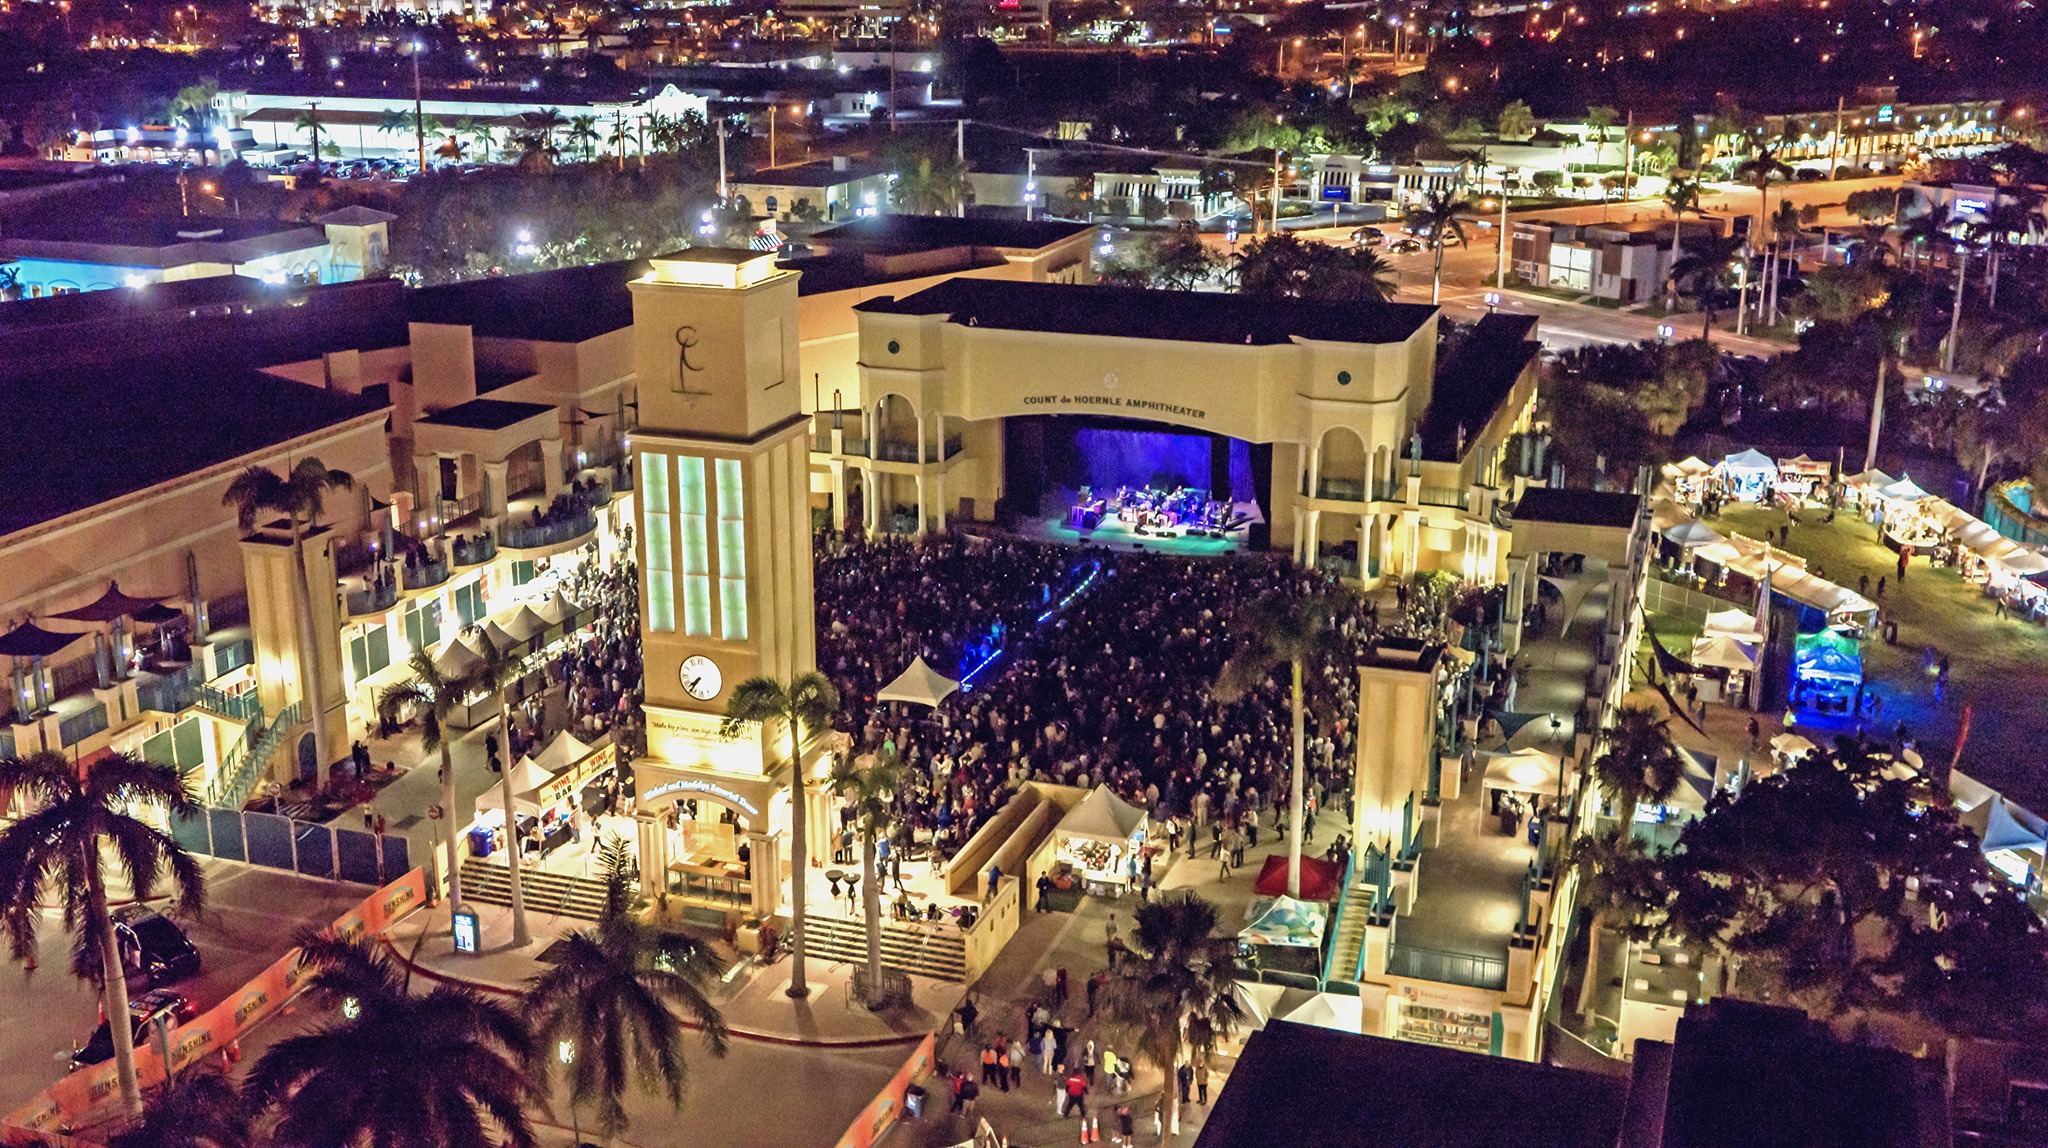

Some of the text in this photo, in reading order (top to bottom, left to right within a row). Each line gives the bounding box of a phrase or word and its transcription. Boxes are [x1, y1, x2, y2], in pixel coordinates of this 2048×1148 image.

[1023, 395, 1206, 420] COUNT de HOERNLE AMPHITHEATER
[589, 750, 608, 768] WINE
[551, 775, 571, 792] WINE
[555, 784, 572, 801] BAR
[383, 887, 415, 919] SUNSHINE
[90, 1068, 141, 1102] SUNSE
